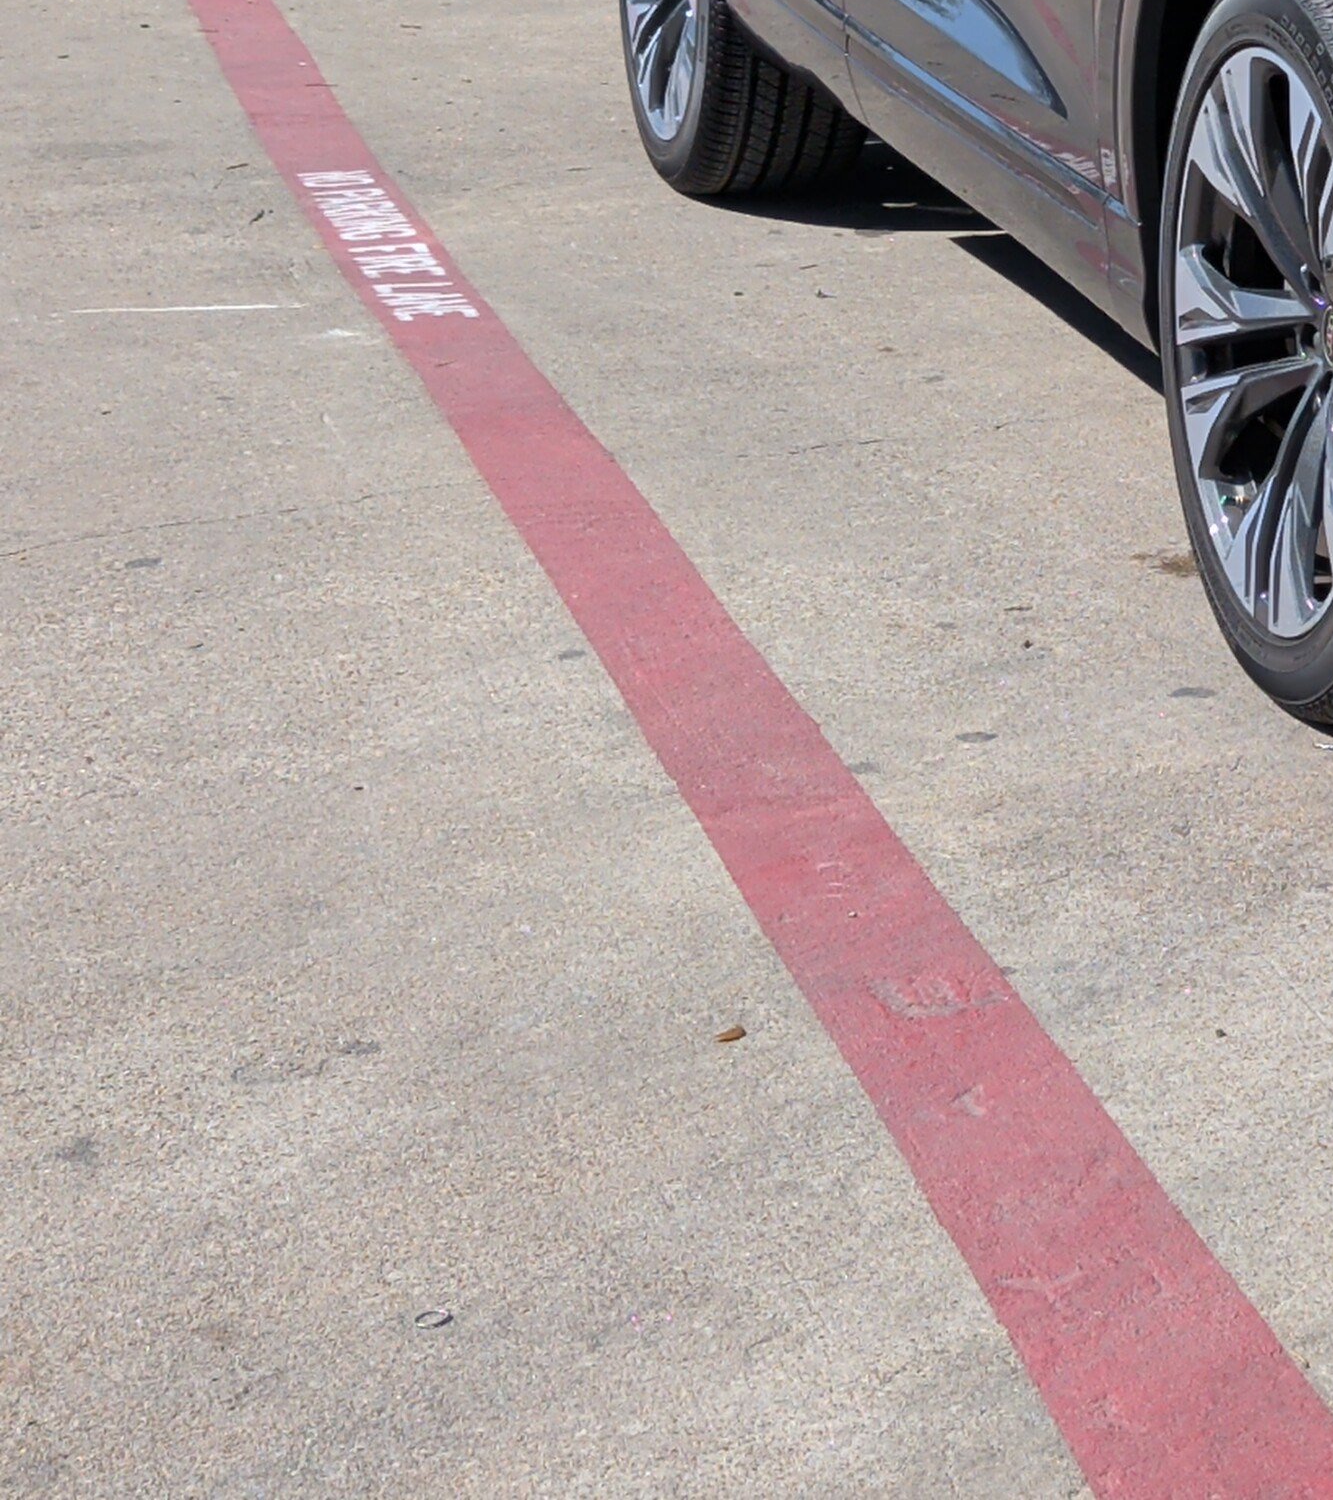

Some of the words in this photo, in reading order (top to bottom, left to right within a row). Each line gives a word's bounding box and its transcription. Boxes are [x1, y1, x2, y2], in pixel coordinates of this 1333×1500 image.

[311, 187, 417, 241] PARKING
[347, 242, 447, 278] FIRE
[372, 281, 480, 321] LANE
